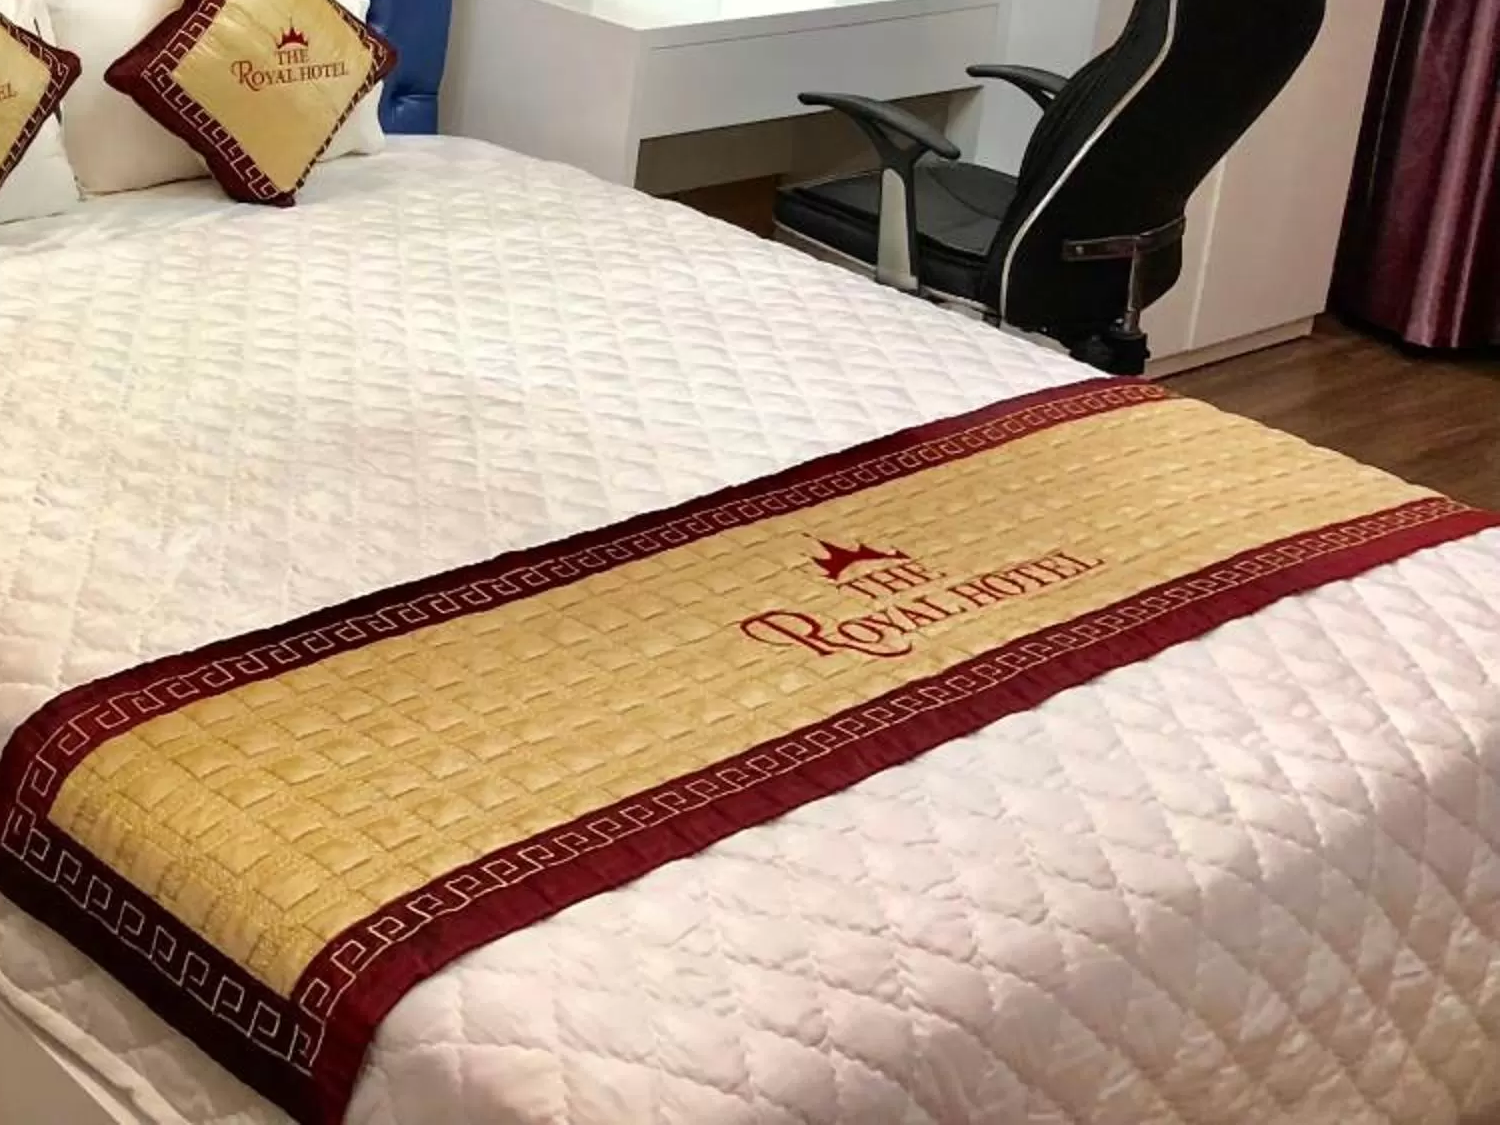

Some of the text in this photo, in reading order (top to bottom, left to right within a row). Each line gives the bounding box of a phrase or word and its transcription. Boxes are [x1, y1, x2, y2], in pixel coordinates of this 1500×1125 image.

[275, 48, 310, 66] THE
[231, 60, 349, 91] ROYAL HOTEL
[835, 561, 948, 600] THE
[740, 550, 1106, 658] ROYAL HOTEL
